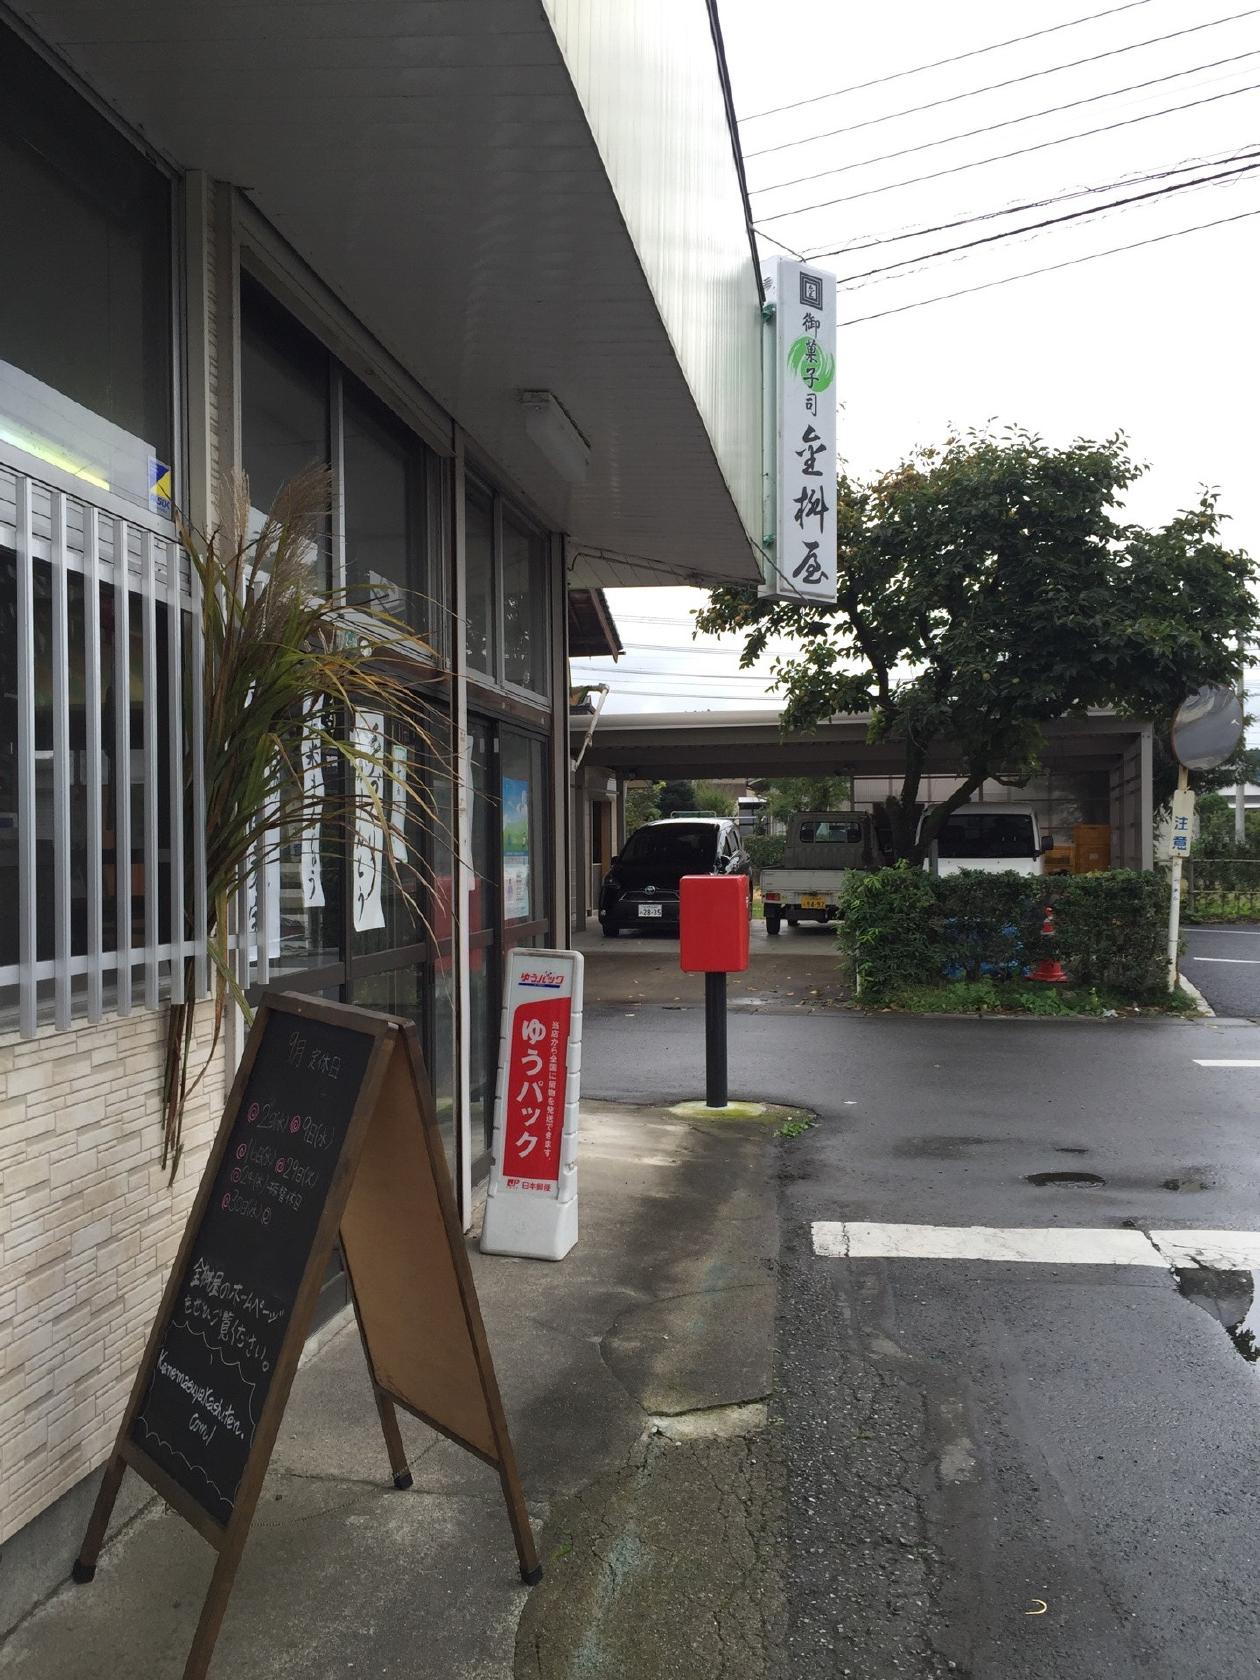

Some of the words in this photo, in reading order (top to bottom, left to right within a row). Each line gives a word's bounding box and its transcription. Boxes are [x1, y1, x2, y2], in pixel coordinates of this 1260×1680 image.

[802, 312, 821, 417] 御菓子司
[1172, 816, 1188, 850] 注意
[520, 970, 565, 985] ゆうパック
[515, 1019, 546, 1158] ゆうパック
